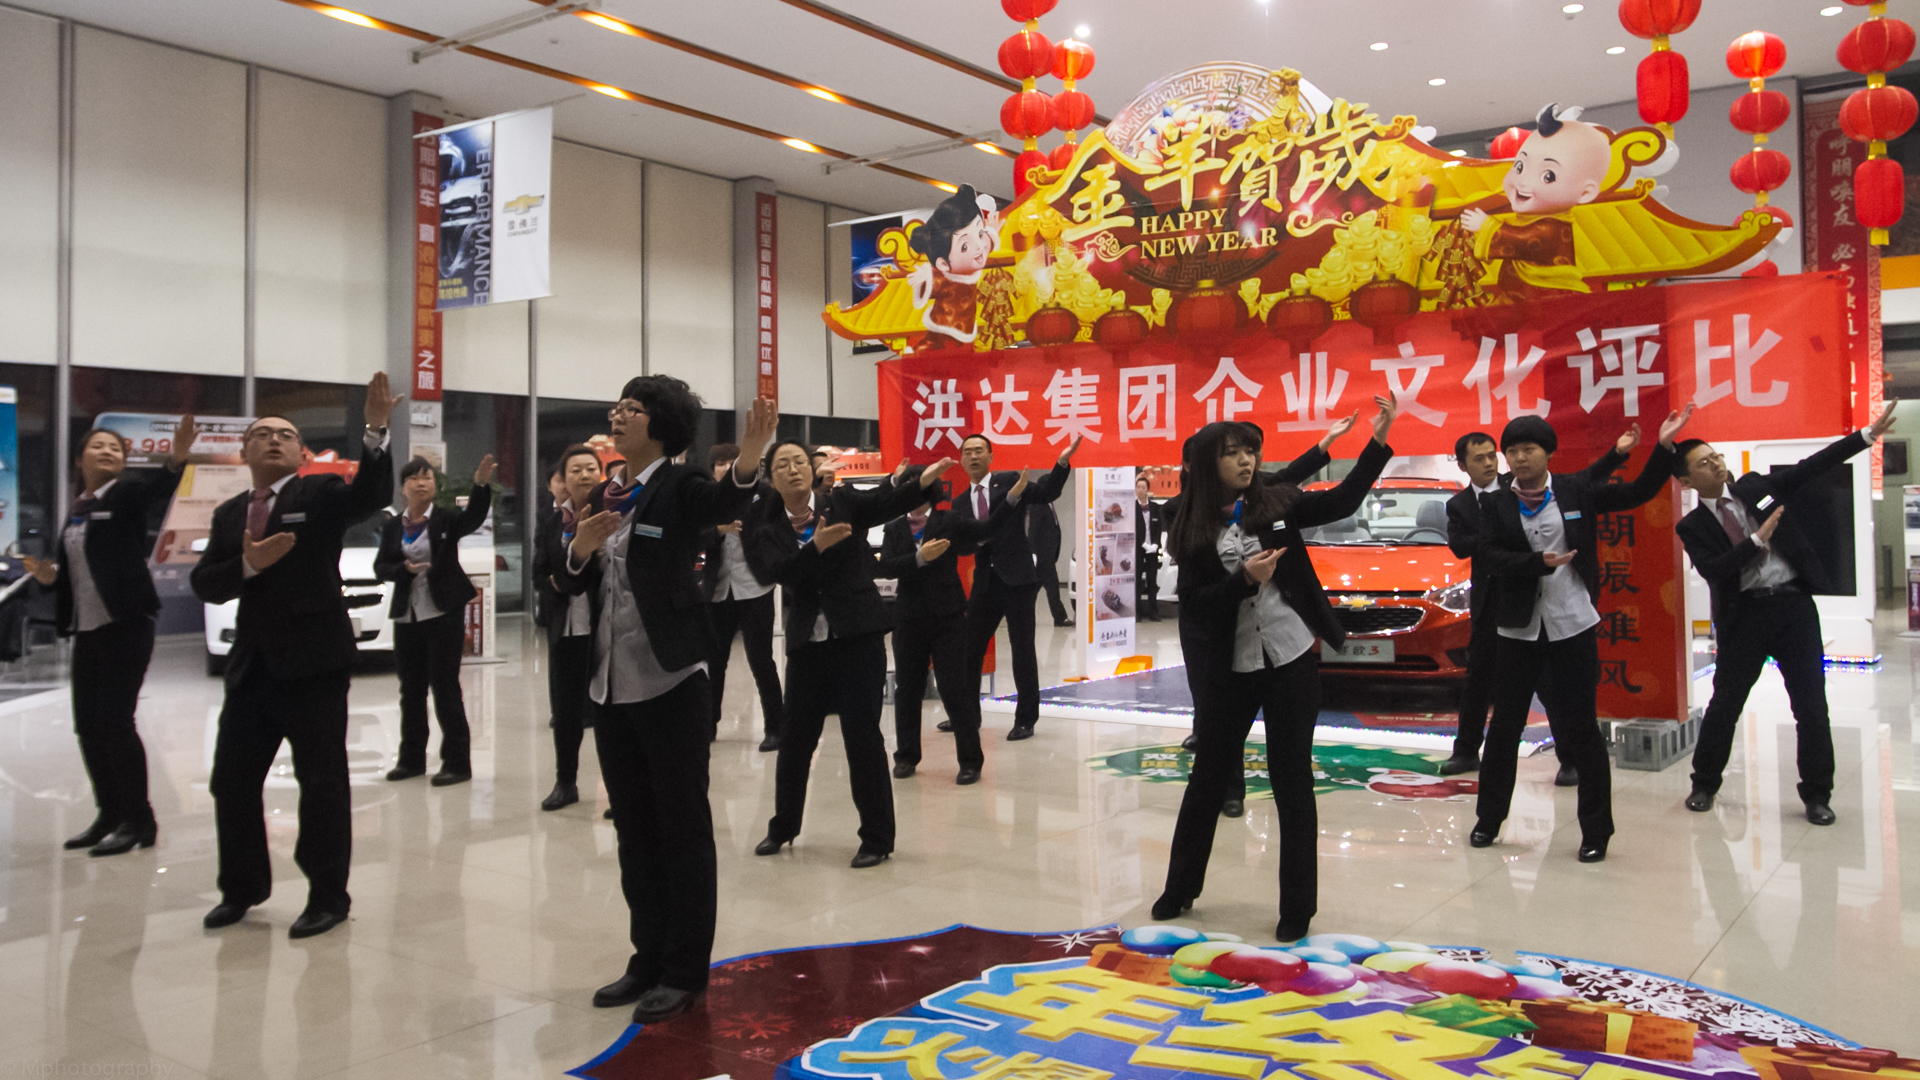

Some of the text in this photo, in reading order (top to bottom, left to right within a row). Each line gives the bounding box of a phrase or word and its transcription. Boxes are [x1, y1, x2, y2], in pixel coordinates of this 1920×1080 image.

[1140, 207, 1228, 236] HAPPY
[1141, 227, 1278, 259] NEW YEAR
[911, 313, 1790, 450] 洪达集团企业文化评比
